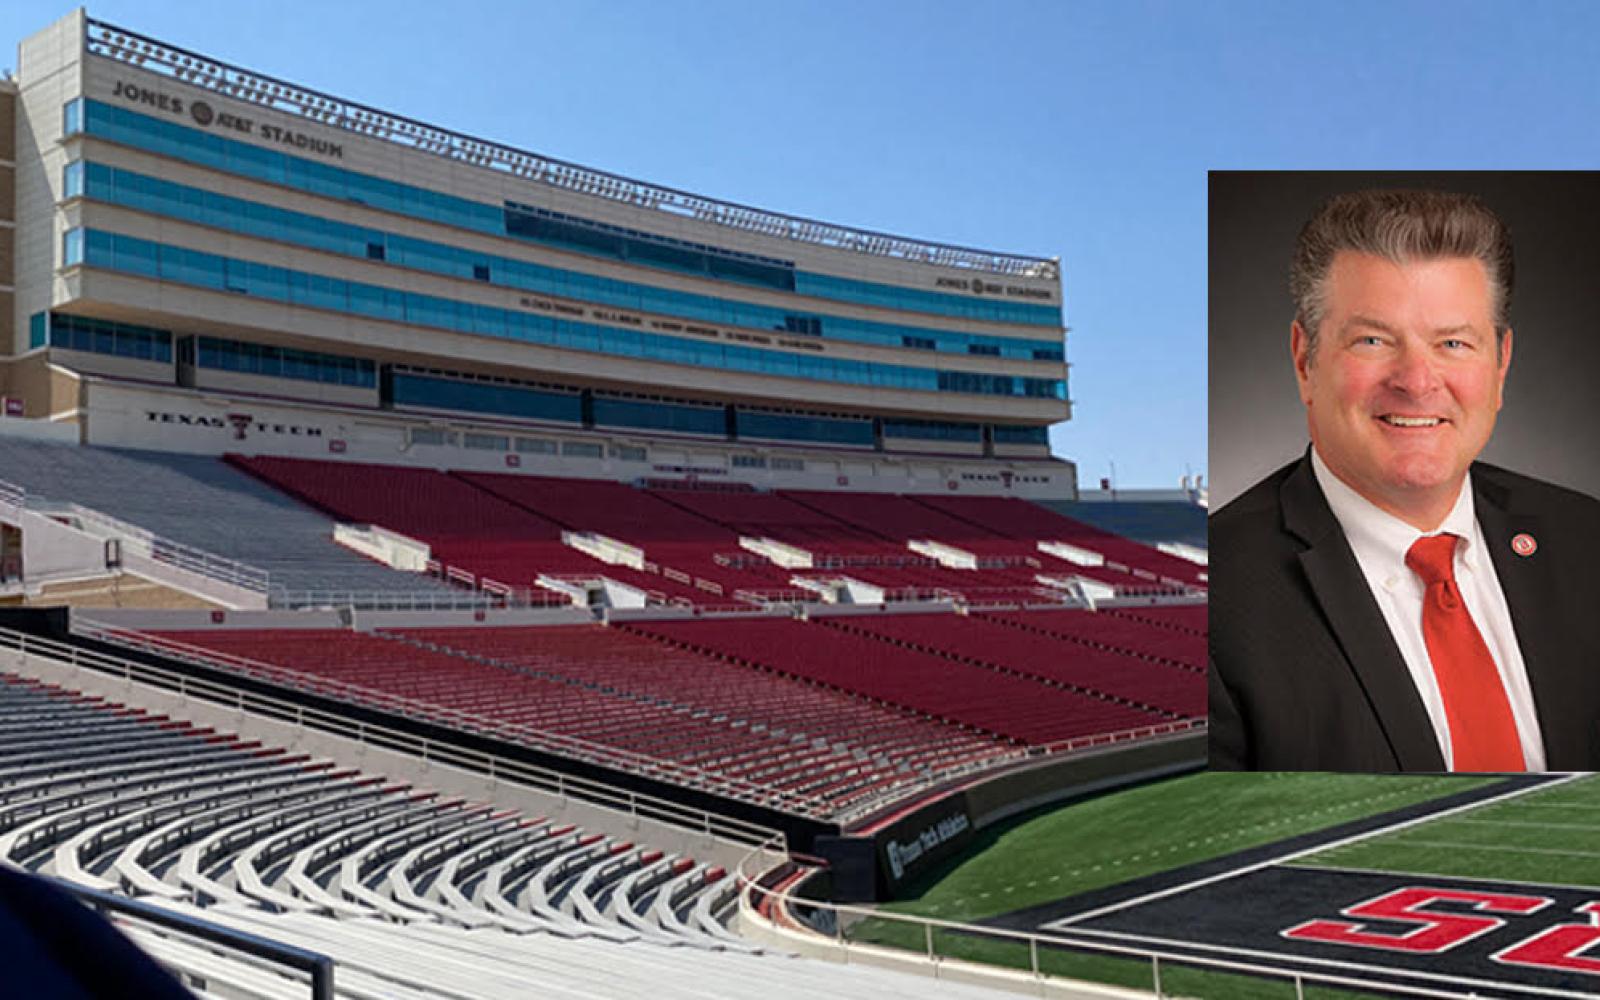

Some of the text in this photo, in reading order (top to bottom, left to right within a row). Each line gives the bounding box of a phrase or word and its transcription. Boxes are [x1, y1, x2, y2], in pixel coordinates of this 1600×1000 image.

[112, 79, 343, 159] JONES AT&T STADIUM
[145, 411, 225, 428] TEXAS
[256, 422, 322, 437] TECH
